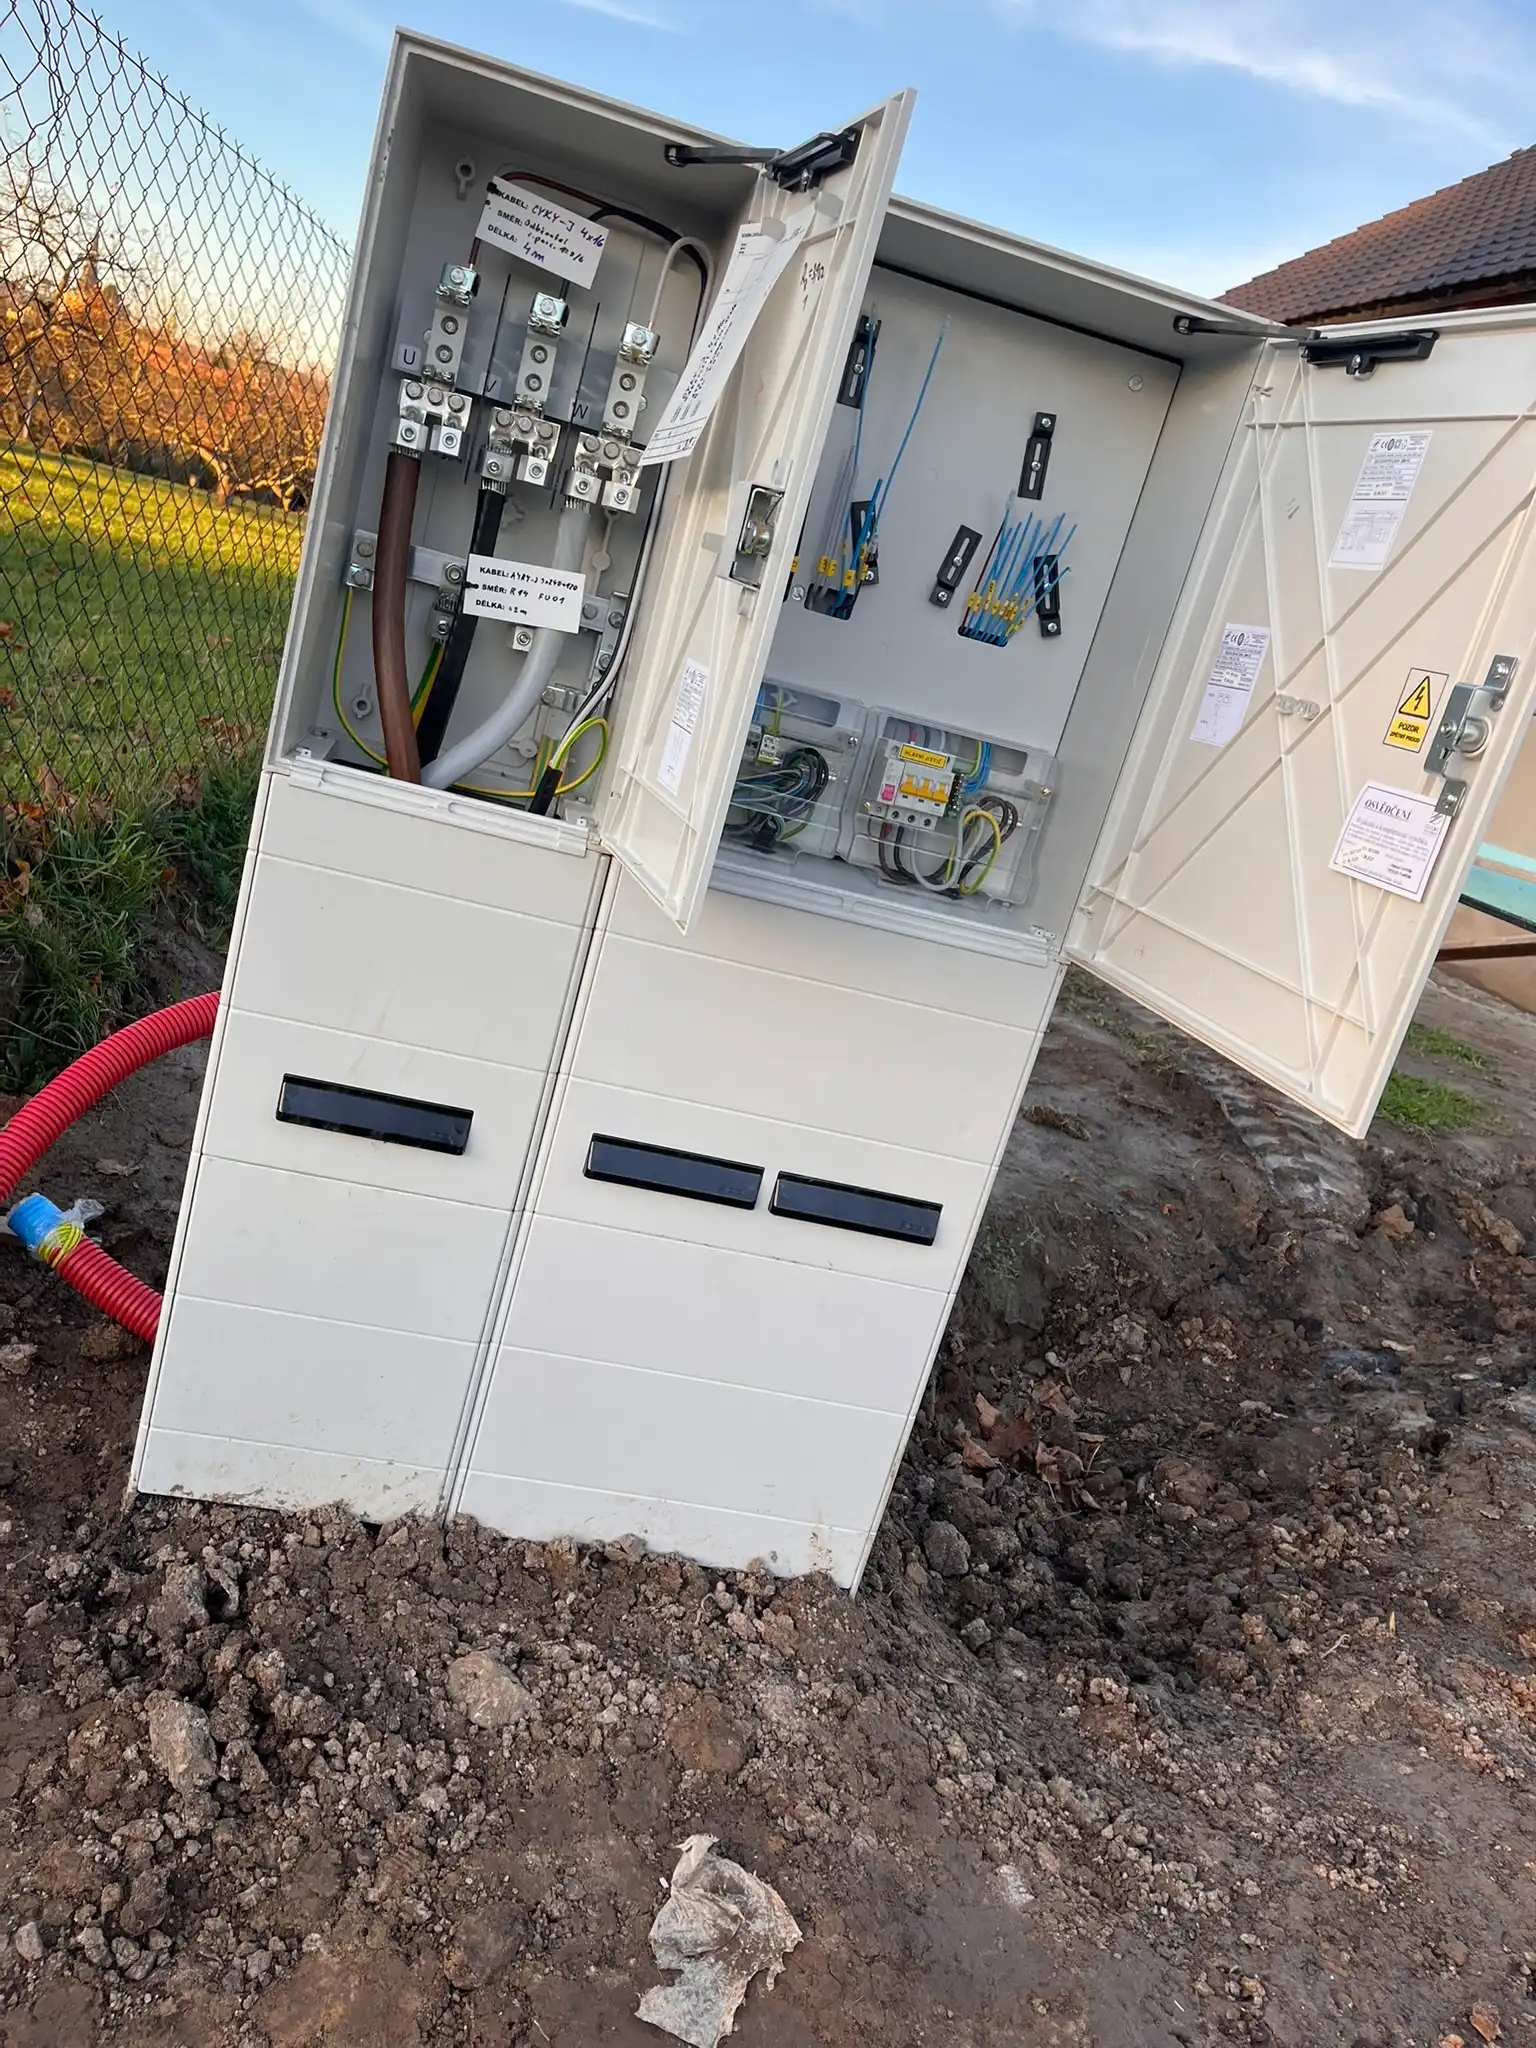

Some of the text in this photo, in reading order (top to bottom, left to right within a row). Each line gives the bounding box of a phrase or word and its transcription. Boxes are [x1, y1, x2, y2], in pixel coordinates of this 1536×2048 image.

[403, 348, 416, 365] U
[479, 566, 509, 579] KABEL:
[482, 583, 507, 594] SMĚR:
[475, 599, 505, 611] DÉLKA:
[1364, 799, 1412, 819] OSVĚDČENÍ
